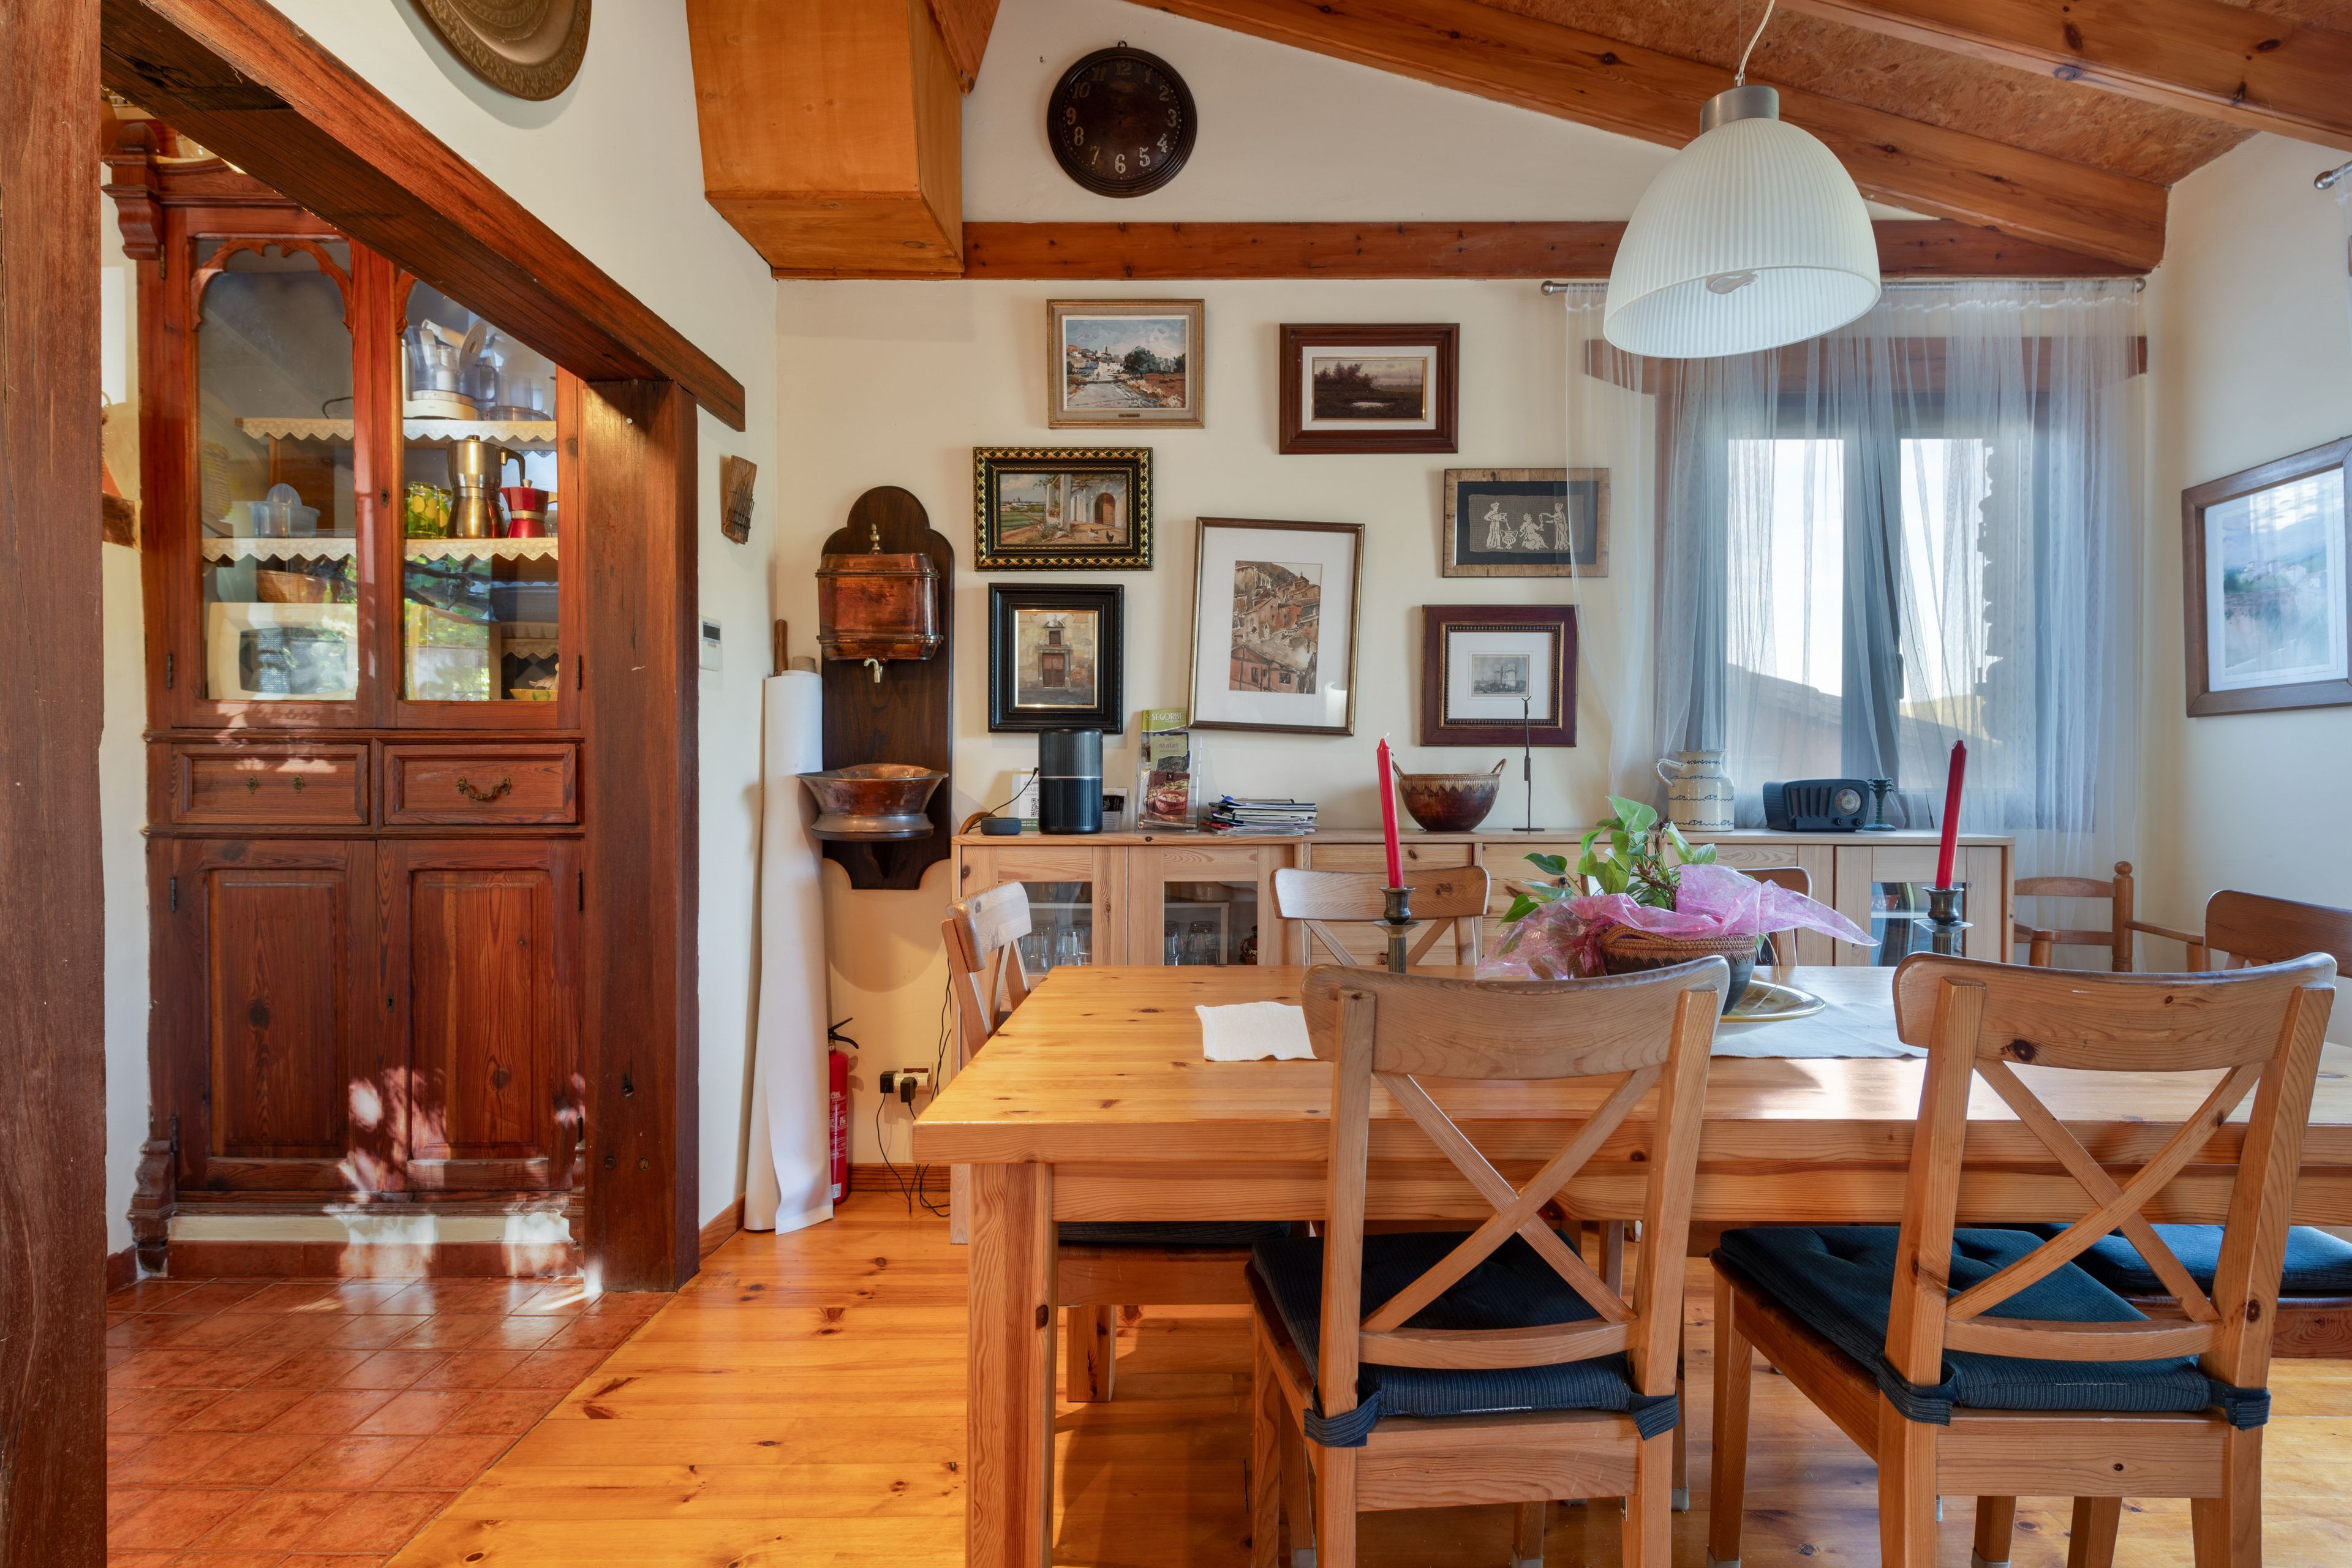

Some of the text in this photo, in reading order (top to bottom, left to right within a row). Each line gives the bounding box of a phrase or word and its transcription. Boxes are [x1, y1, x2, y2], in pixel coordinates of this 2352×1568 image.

[1091, 67, 1106, 81] 11
[1115, 62, 1132, 76] 12
[1144, 70, 1151, 85] 1
[1072, 81, 1091, 99] 10
[1158, 85, 1169, 101] 2
[1066, 107, 1077, 125] 9
[1167, 108, 1177, 127] 3
[1074, 126, 1084, 146] 8
[1157, 133, 1167, 153] 4
[1090, 145, 1101, 165] 7
[1115, 154, 1126, 174] 6
[1139, 146, 1150, 167] 5
[1152, 712, 1183, 721] SEGORBE
